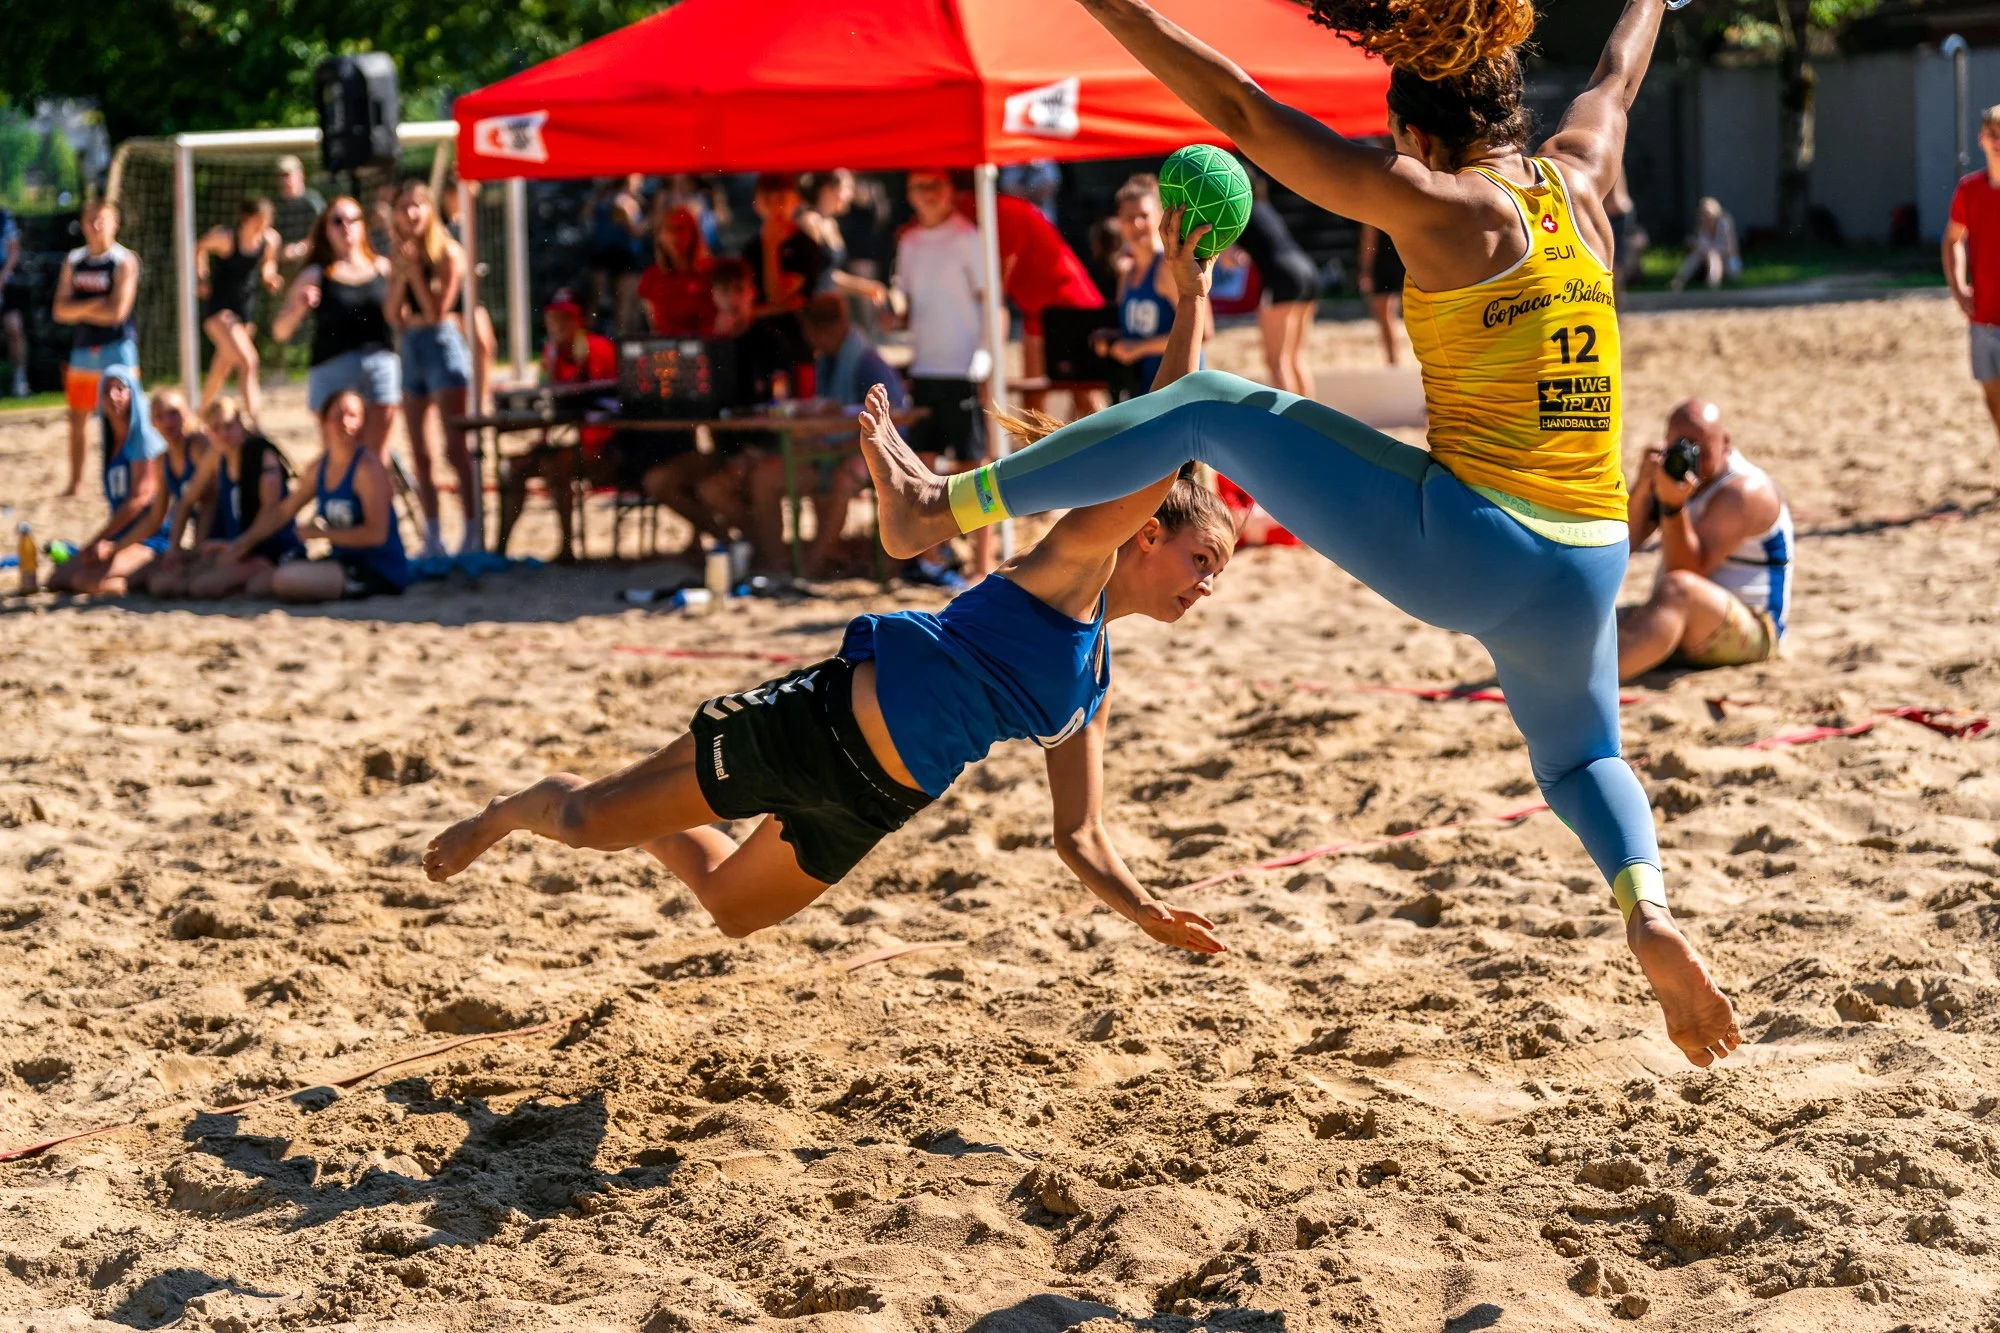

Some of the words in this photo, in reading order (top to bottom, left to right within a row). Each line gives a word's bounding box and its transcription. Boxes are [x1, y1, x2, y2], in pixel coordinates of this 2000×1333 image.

[1544, 245, 1575, 260] SUI
[1550, 324, 1599, 364] 12
[1579, 377, 1607, 392] WE
[1569, 397, 1610, 411] PLAY
[1542, 418, 1610, 429] HANDBALL.CH
